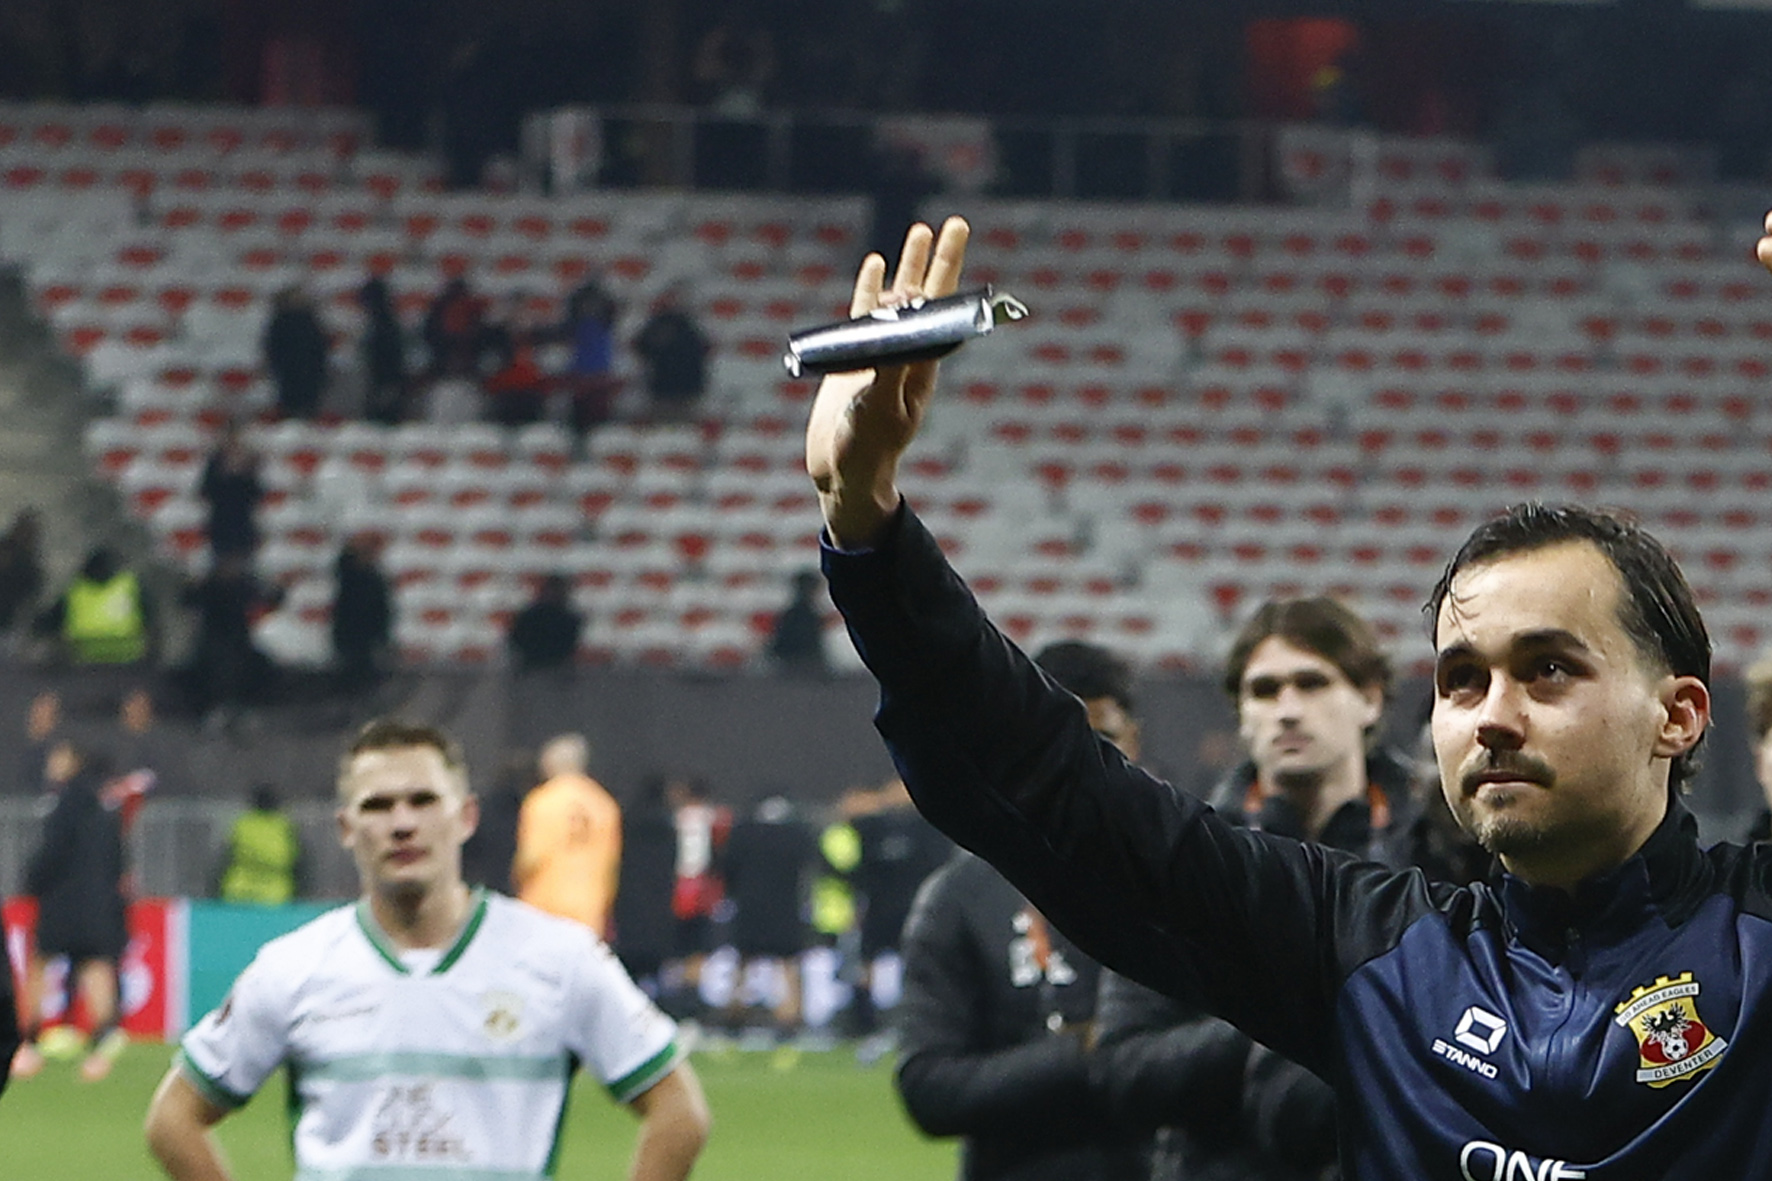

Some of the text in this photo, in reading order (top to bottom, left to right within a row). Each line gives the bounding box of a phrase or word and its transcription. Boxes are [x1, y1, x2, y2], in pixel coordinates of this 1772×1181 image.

[1632, 994, 1660, 1012] AHEAD
[1662, 985, 1697, 998] EAGLES
[1431, 1038, 1498, 1079] STANNO
[1654, 1048, 1713, 1079] DEVENTER
